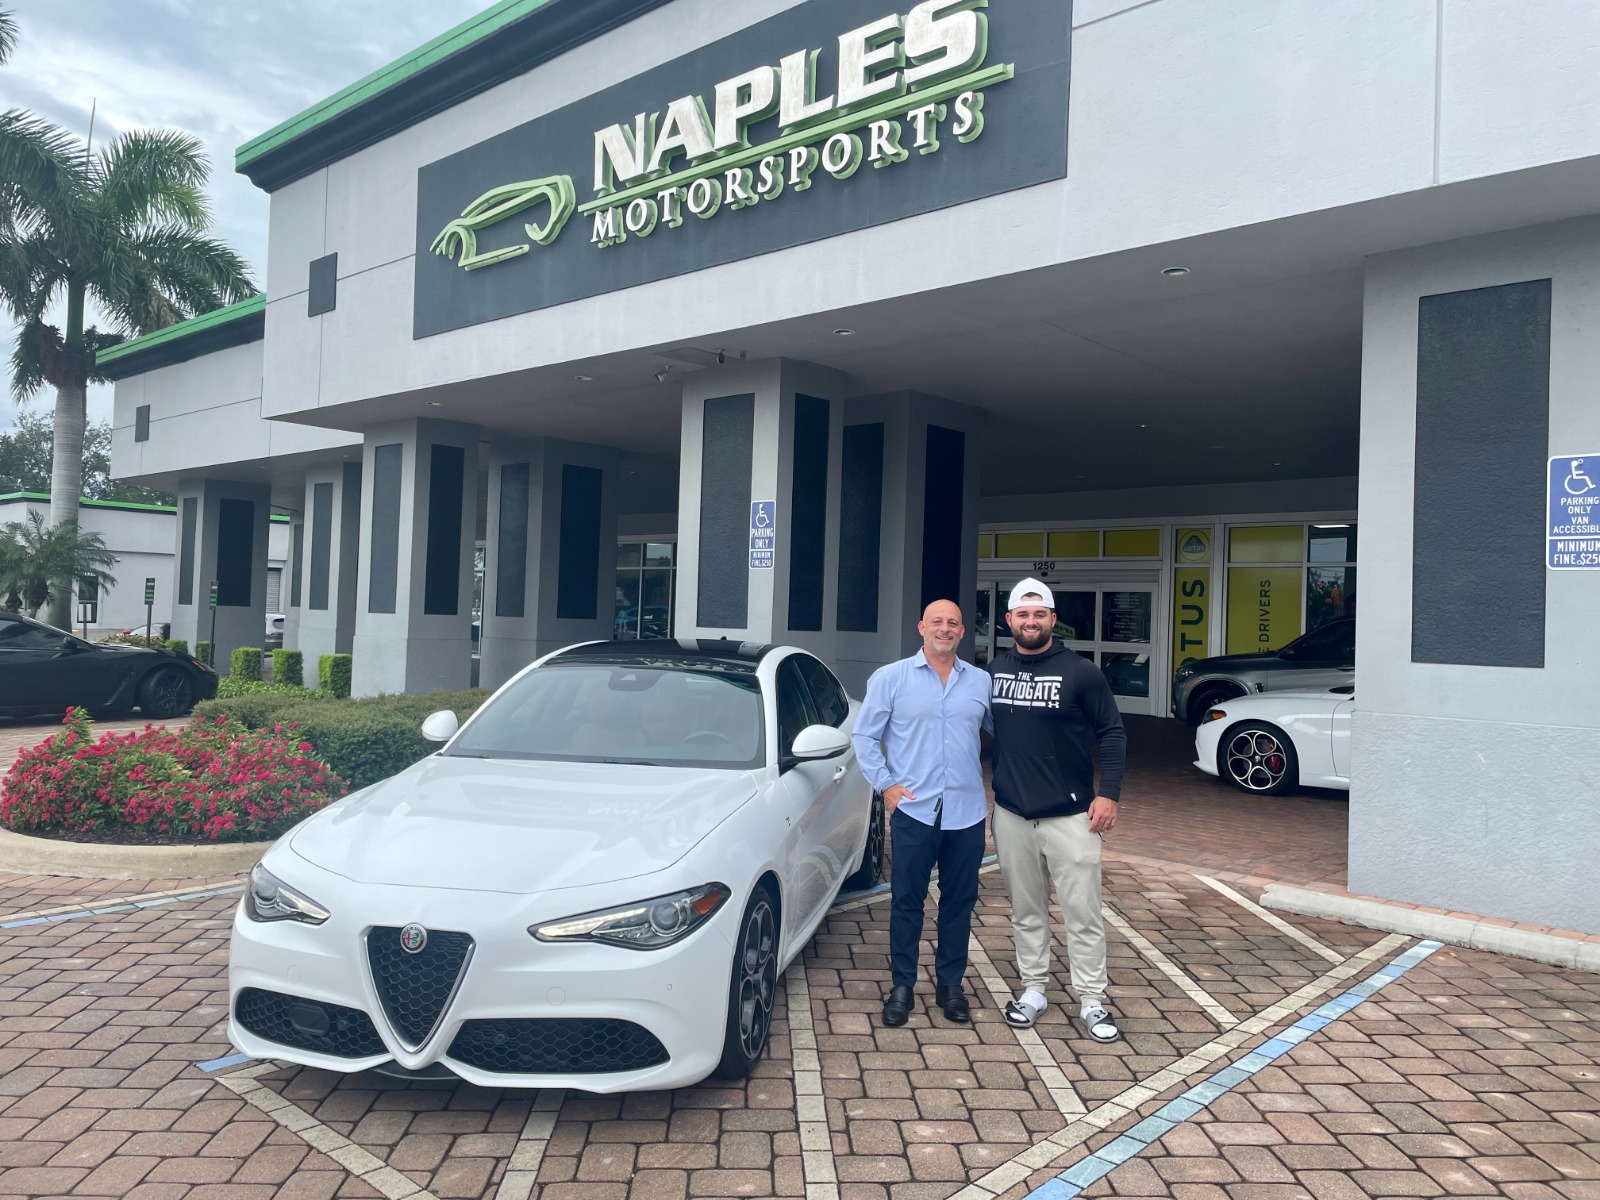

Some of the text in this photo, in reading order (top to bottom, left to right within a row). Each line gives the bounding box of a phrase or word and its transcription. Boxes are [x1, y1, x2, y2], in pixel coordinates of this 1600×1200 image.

[593, 0, 980, 192] NAPLES
[590, 91, 979, 244] MOTORSPORTS
[1561, 496, 1600, 505] PARKING
[1568, 506, 1592, 514] ONLY
[1571, 516, 1589, 524] VAN
[752, 528, 773, 537] PARKING
[755, 539, 769, 548] ONLY
[1554, 553, 1600, 566] FINE $25
[1033, 562, 1055, 571] 1250
[1259, 579, 1271, 643] DRIVERS
[1181, 579, 1205, 664] TUS
[1017, 671, 1033, 682] THE
